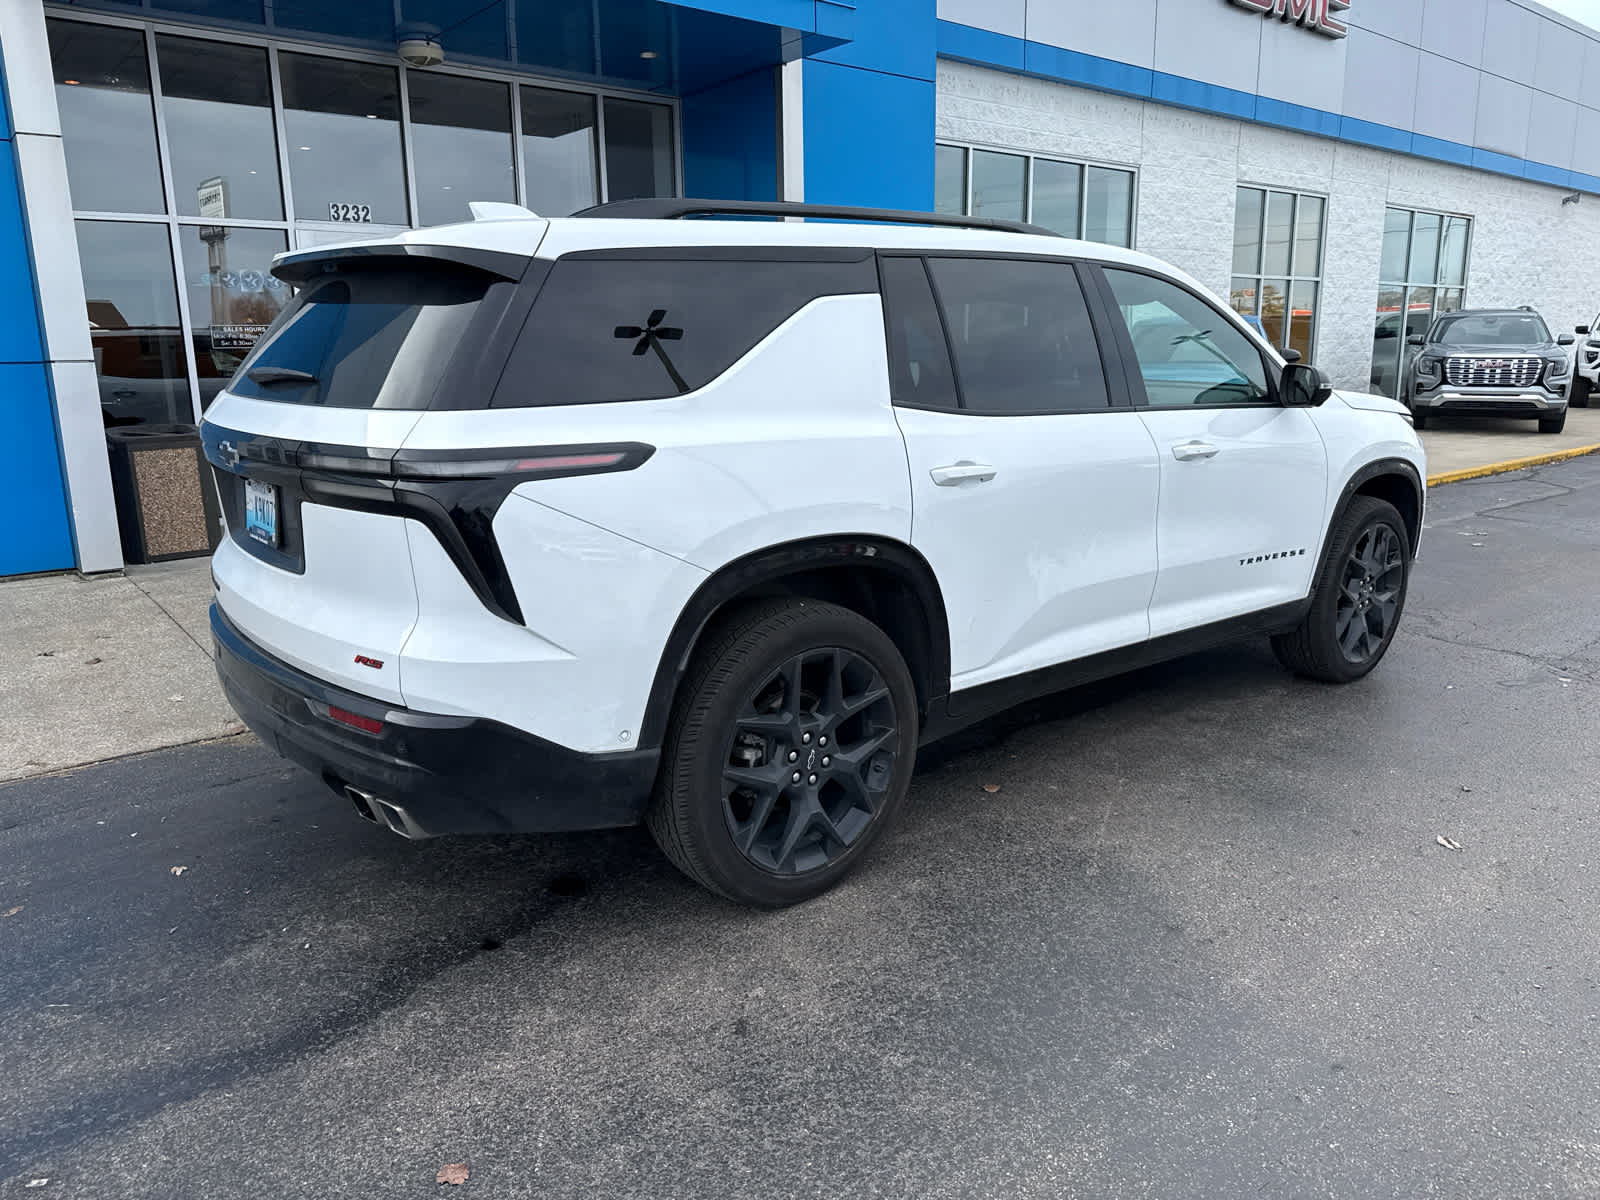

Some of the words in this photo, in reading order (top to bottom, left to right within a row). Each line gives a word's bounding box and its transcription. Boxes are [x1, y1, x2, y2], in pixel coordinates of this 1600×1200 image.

[1229, 0, 1351, 38] MC
[331, 203, 371, 223] 3232
[1239, 548, 1306, 566] TRAVERSE
[354, 655, 385, 669] RS
